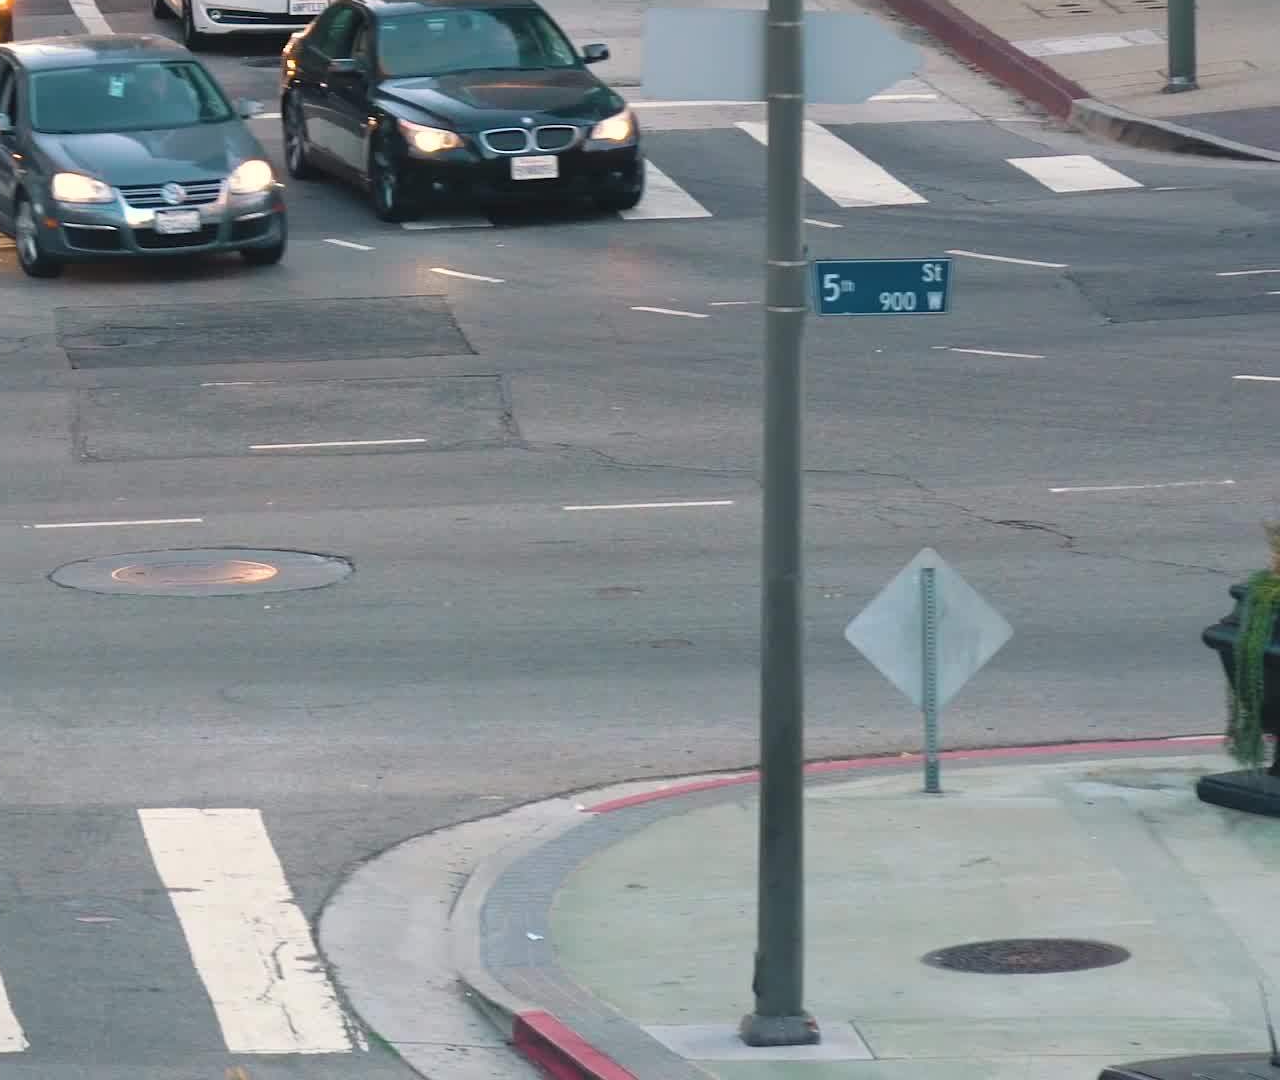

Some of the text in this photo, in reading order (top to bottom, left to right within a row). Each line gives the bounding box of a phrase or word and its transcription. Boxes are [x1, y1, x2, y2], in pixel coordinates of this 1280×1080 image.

[922, 263, 943, 282] St
[879, 291, 943, 311] 900 W
